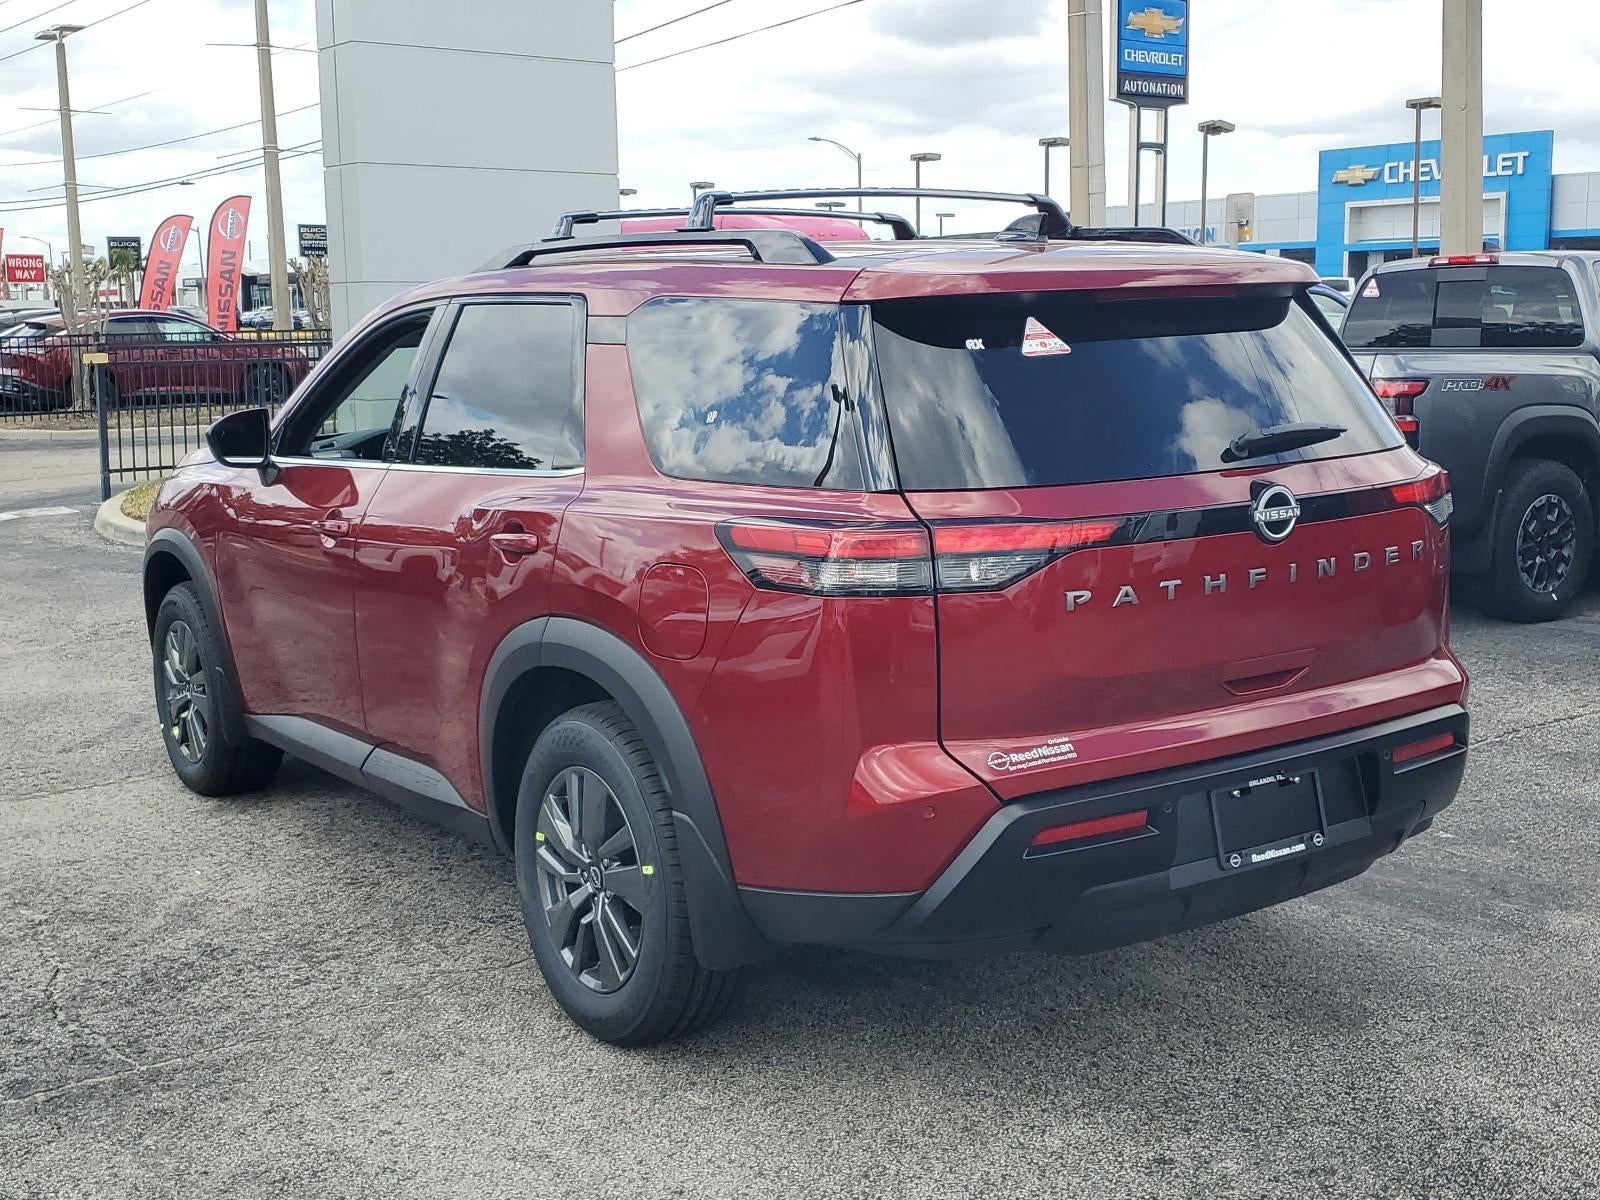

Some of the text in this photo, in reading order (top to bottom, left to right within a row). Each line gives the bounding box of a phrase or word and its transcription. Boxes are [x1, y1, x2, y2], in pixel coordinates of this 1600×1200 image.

[1124, 49, 1184, 66] CHEVROLET
[1123, 80, 1184, 96] AUTONATION
[1383, 151, 1530, 184] CHEVLET
[7, 257, 43, 268] WRONG
[15, 269, 37, 280] WAY
[1255, 506, 1300, 521] NISSAN
[1064, 540, 1425, 612] PATHFINDER
[1047, 736, 1069, 745] Orlando
[1251, 843, 1306, 863] ReedNissan.com
